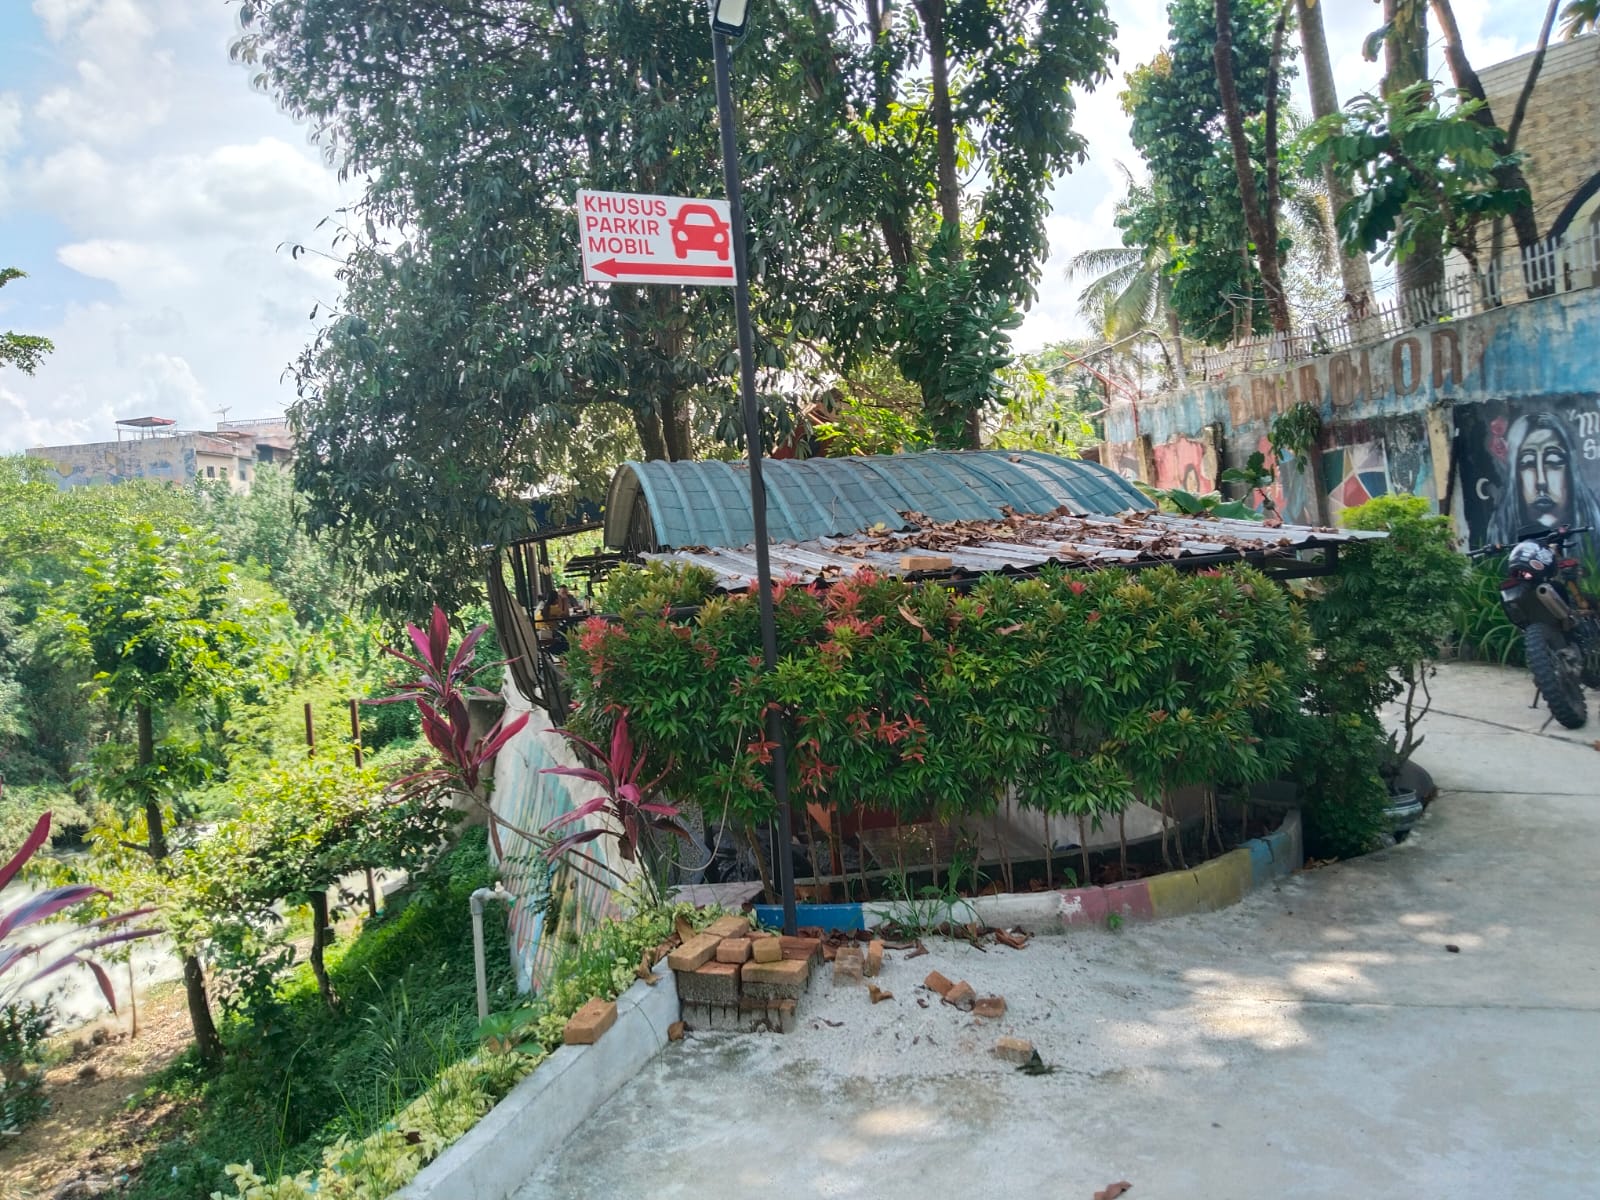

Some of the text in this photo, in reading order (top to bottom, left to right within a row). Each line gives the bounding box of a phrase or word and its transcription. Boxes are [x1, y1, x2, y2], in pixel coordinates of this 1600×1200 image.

[584, 195, 667, 217] KHUSUS
[586, 216, 660, 236] PARKIR
[588, 236, 655, 255] MOBIL
